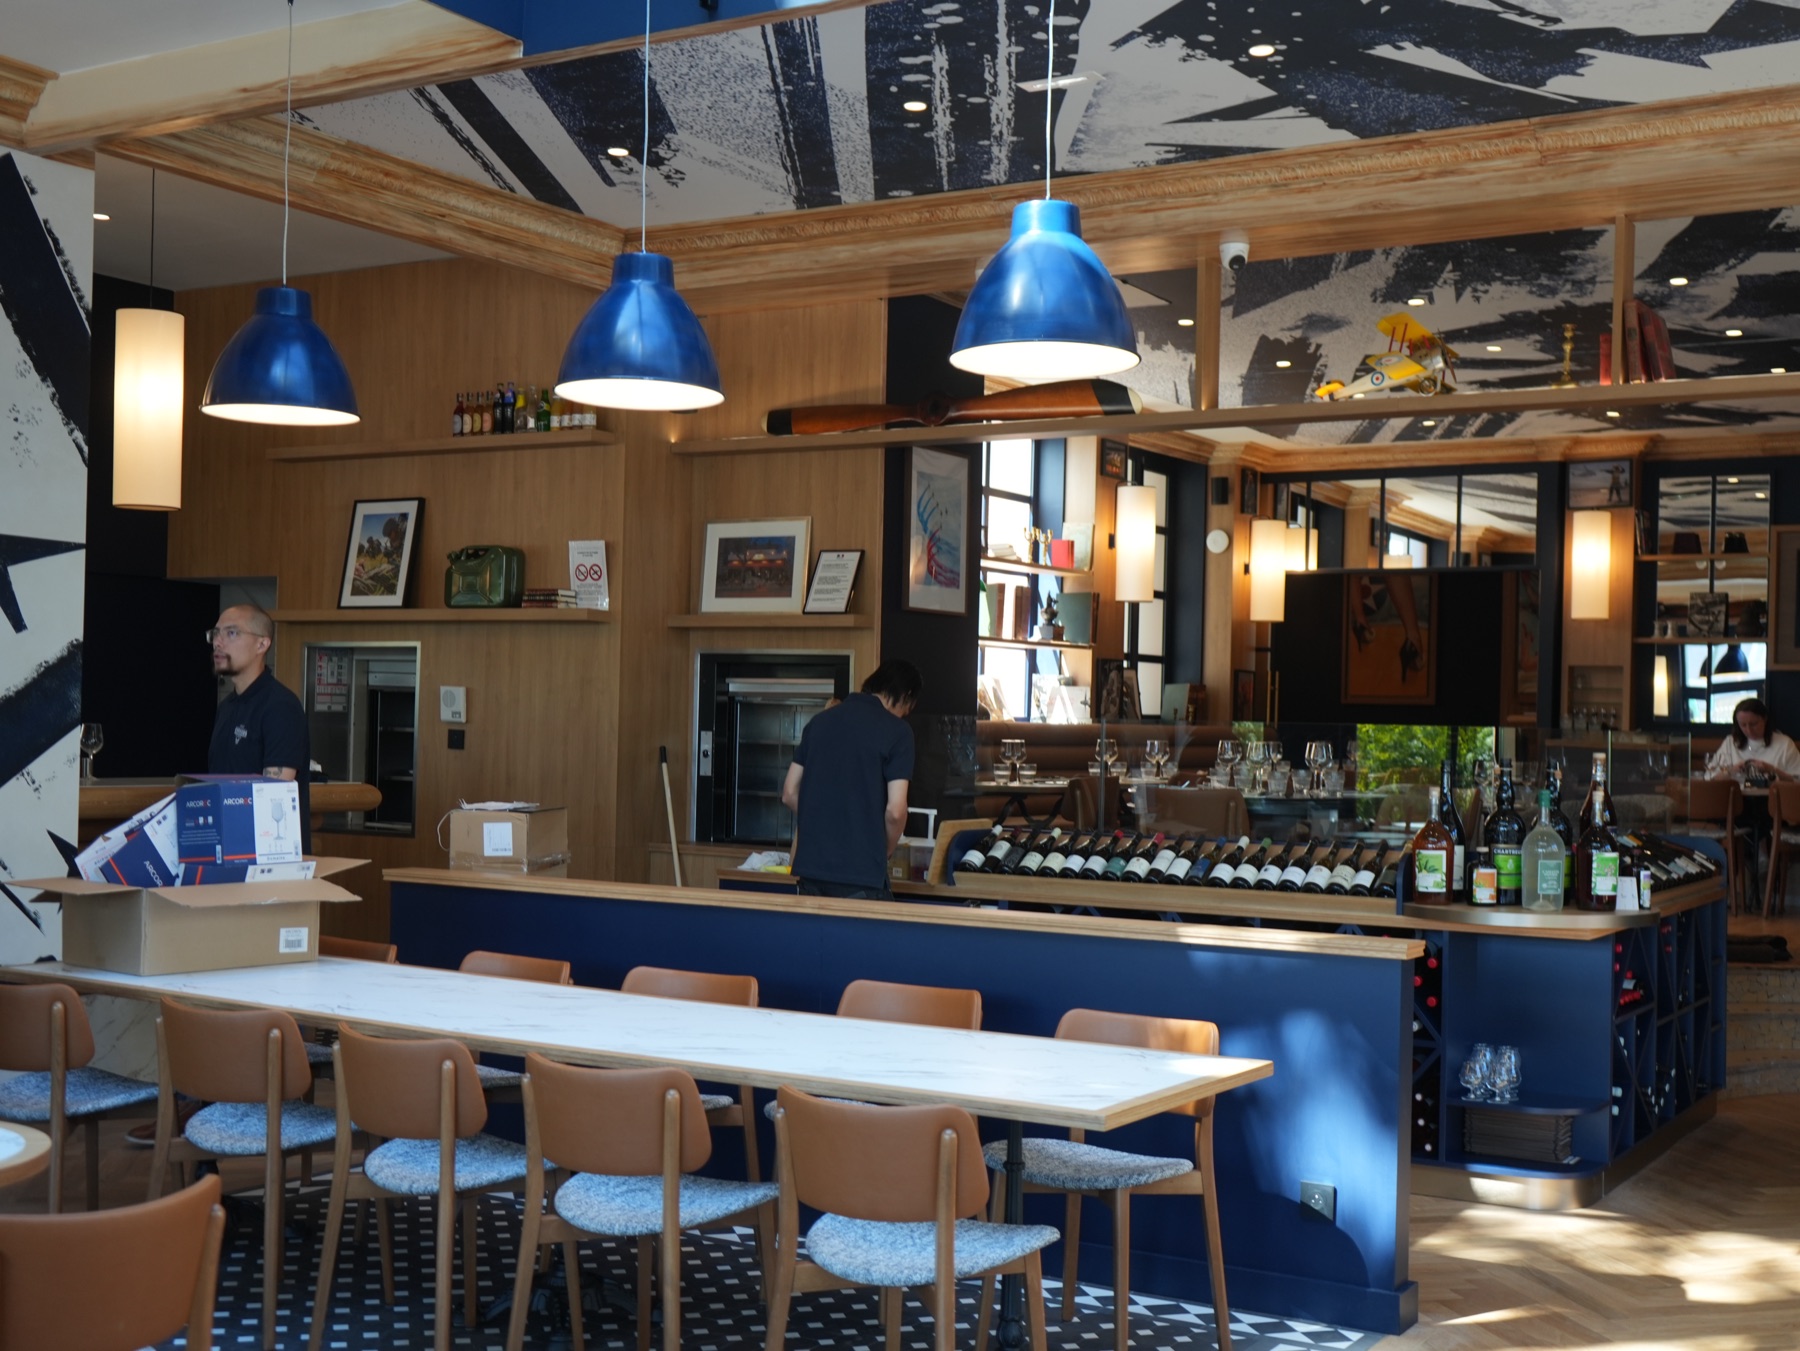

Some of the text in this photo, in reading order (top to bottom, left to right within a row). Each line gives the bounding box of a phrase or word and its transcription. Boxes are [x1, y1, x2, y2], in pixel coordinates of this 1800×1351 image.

[186, 799, 211, 808] ARCOROC
[223, 797, 252, 805] ARCOROC
[144, 860, 164, 887] ARCOR
